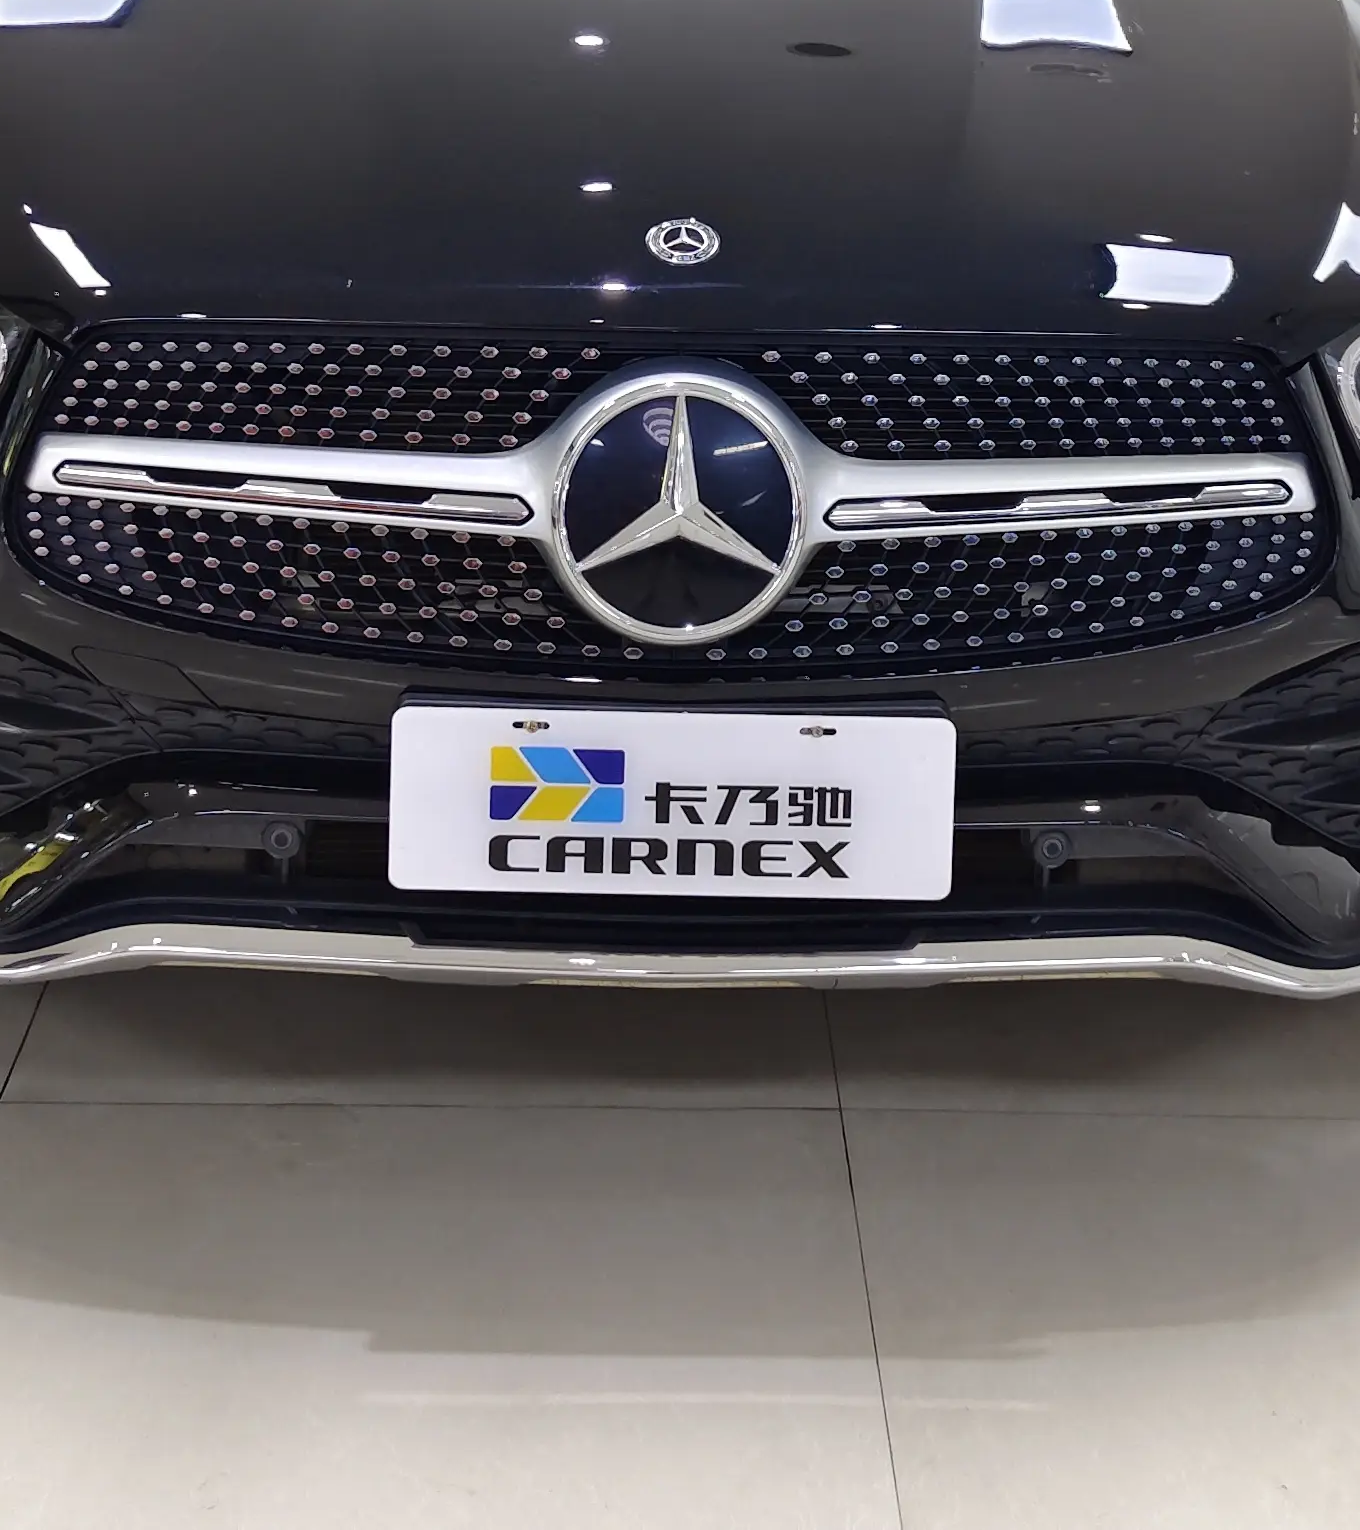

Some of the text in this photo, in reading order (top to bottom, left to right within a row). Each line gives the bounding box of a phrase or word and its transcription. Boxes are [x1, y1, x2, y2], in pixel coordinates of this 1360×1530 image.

[645, 782, 852, 827] 卡乃驰
[488, 835, 851, 879] CARNEX
